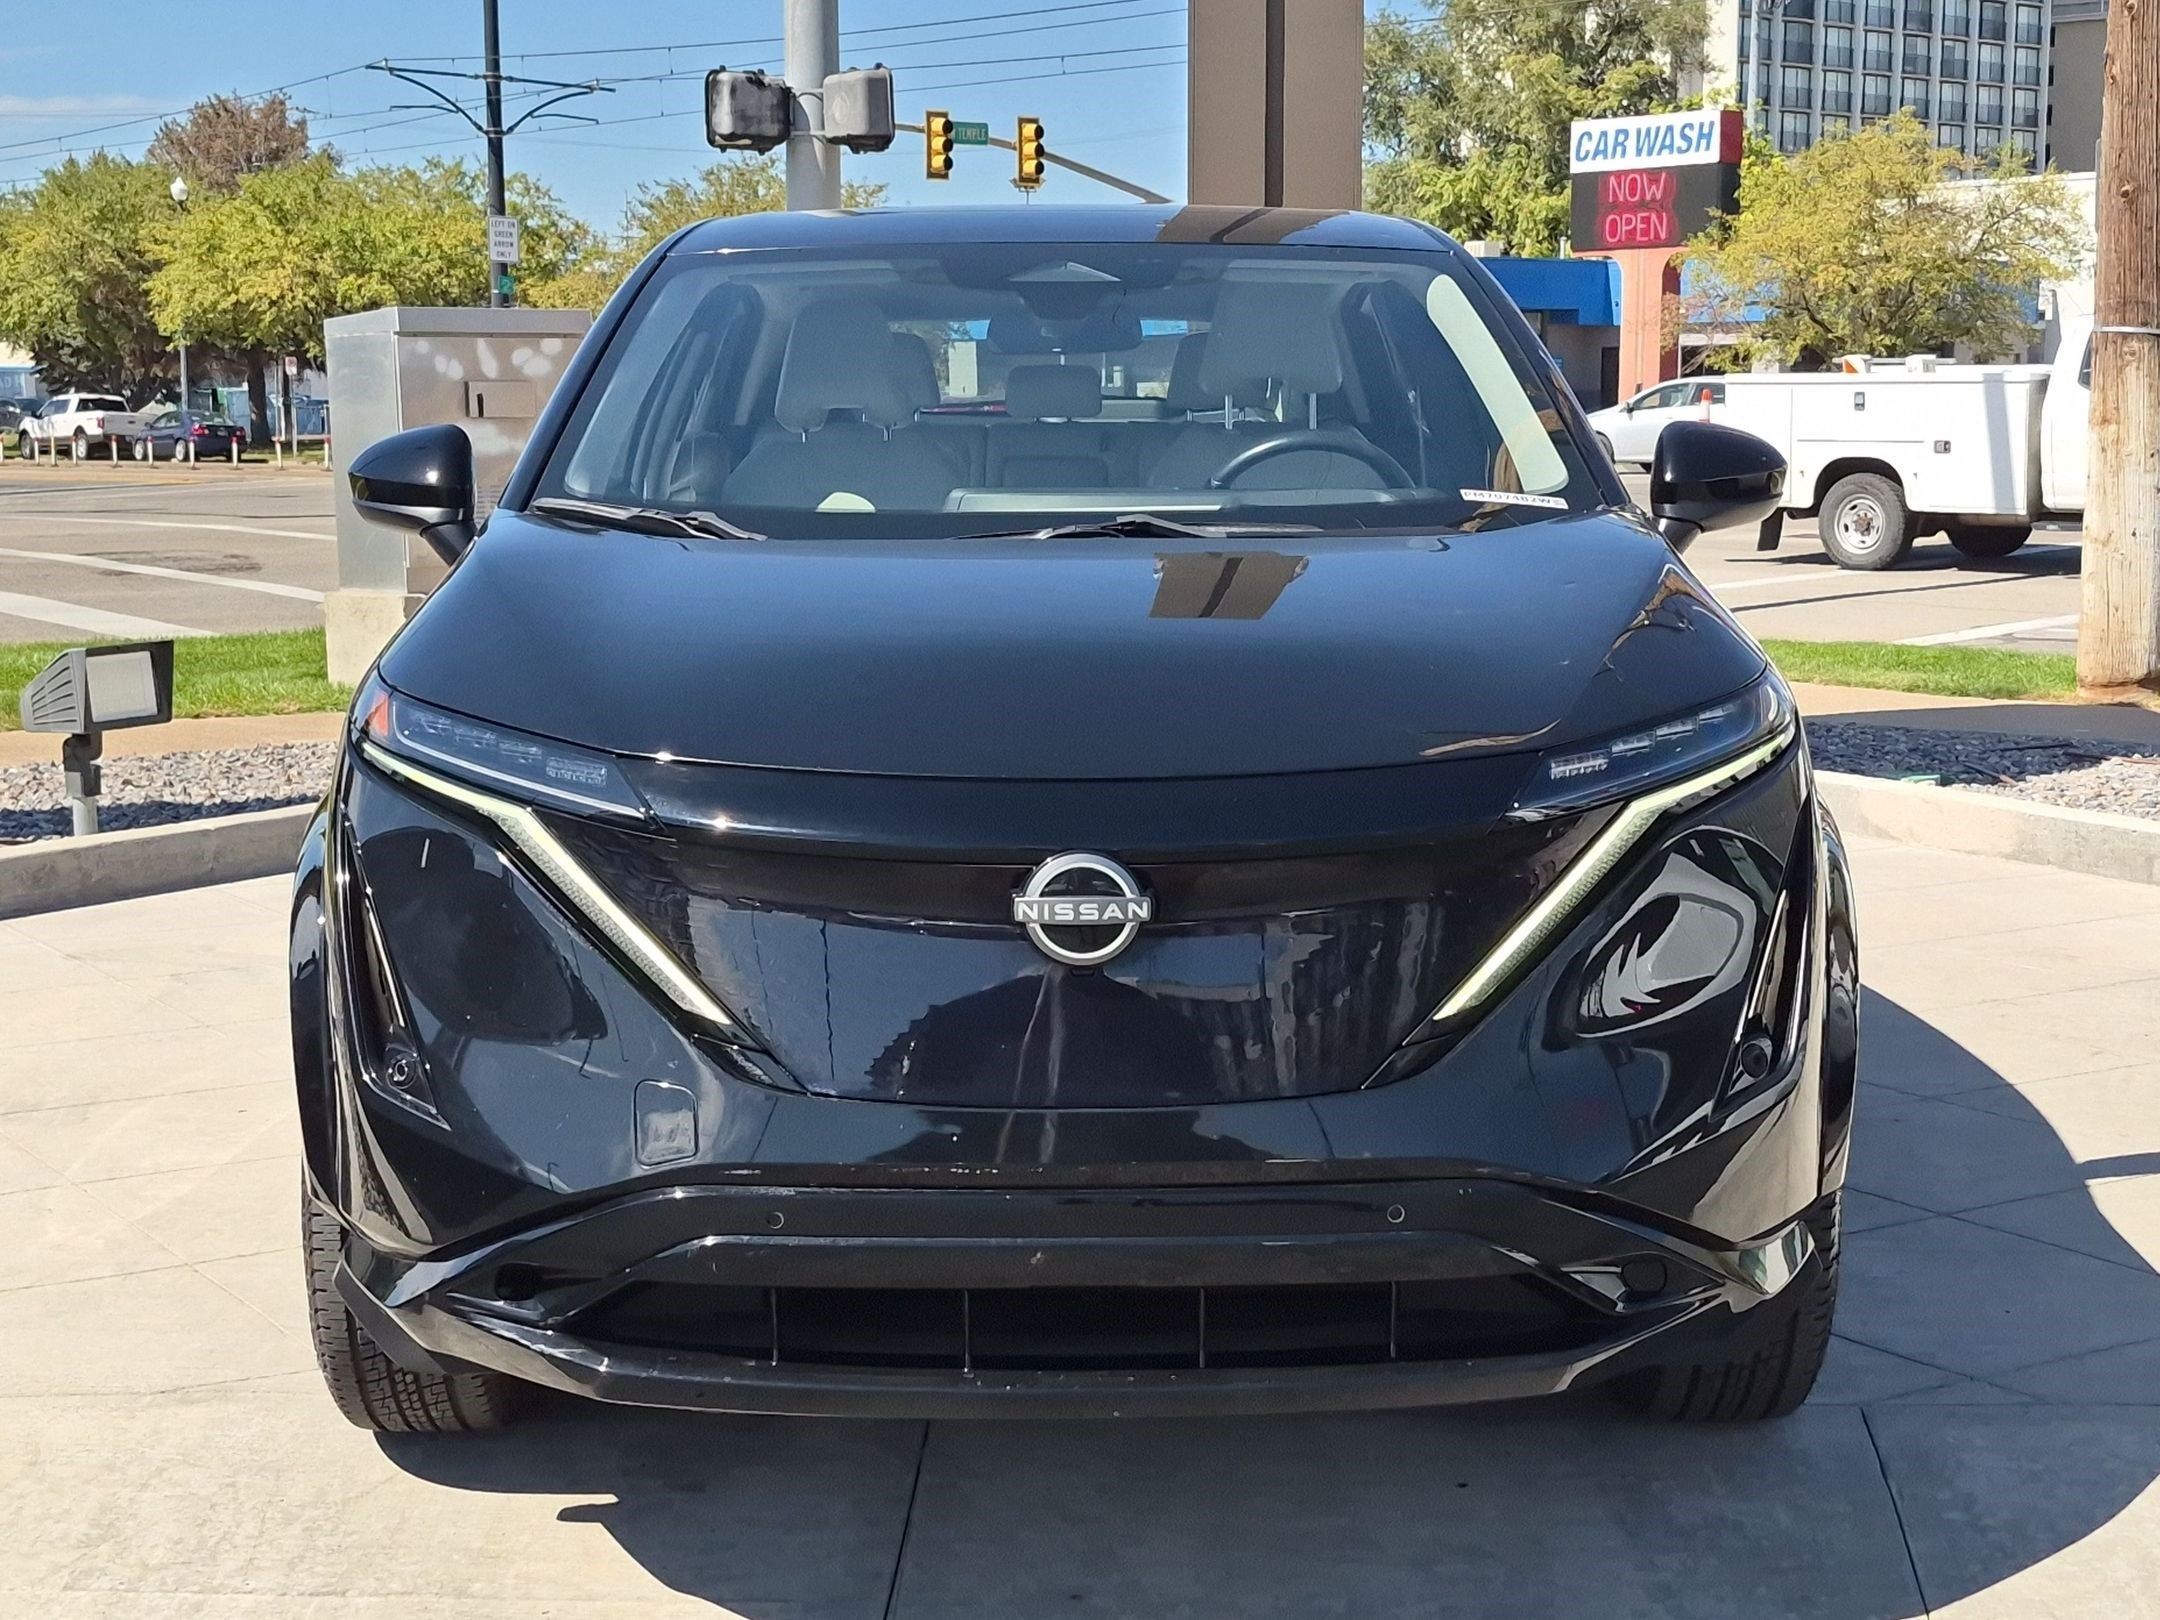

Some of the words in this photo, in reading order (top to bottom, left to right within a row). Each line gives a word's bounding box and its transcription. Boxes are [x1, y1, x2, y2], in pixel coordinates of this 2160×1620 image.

[958, 127, 987, 141] TEMPLE
[1575, 128, 1629, 162] CAR
[1635, 120, 1715, 158] WASH
[1609, 172, 1666, 203] NOW
[491, 220, 505, 228] LEFT
[507, 221, 516, 229] ON
[1605, 212, 1668, 243] OPEN
[494, 230, 513, 238] GREEN
[494, 240, 514, 248] ARROW
[496, 250, 512, 259] ONLY
[1017, 901, 1149, 921] NISSAN
